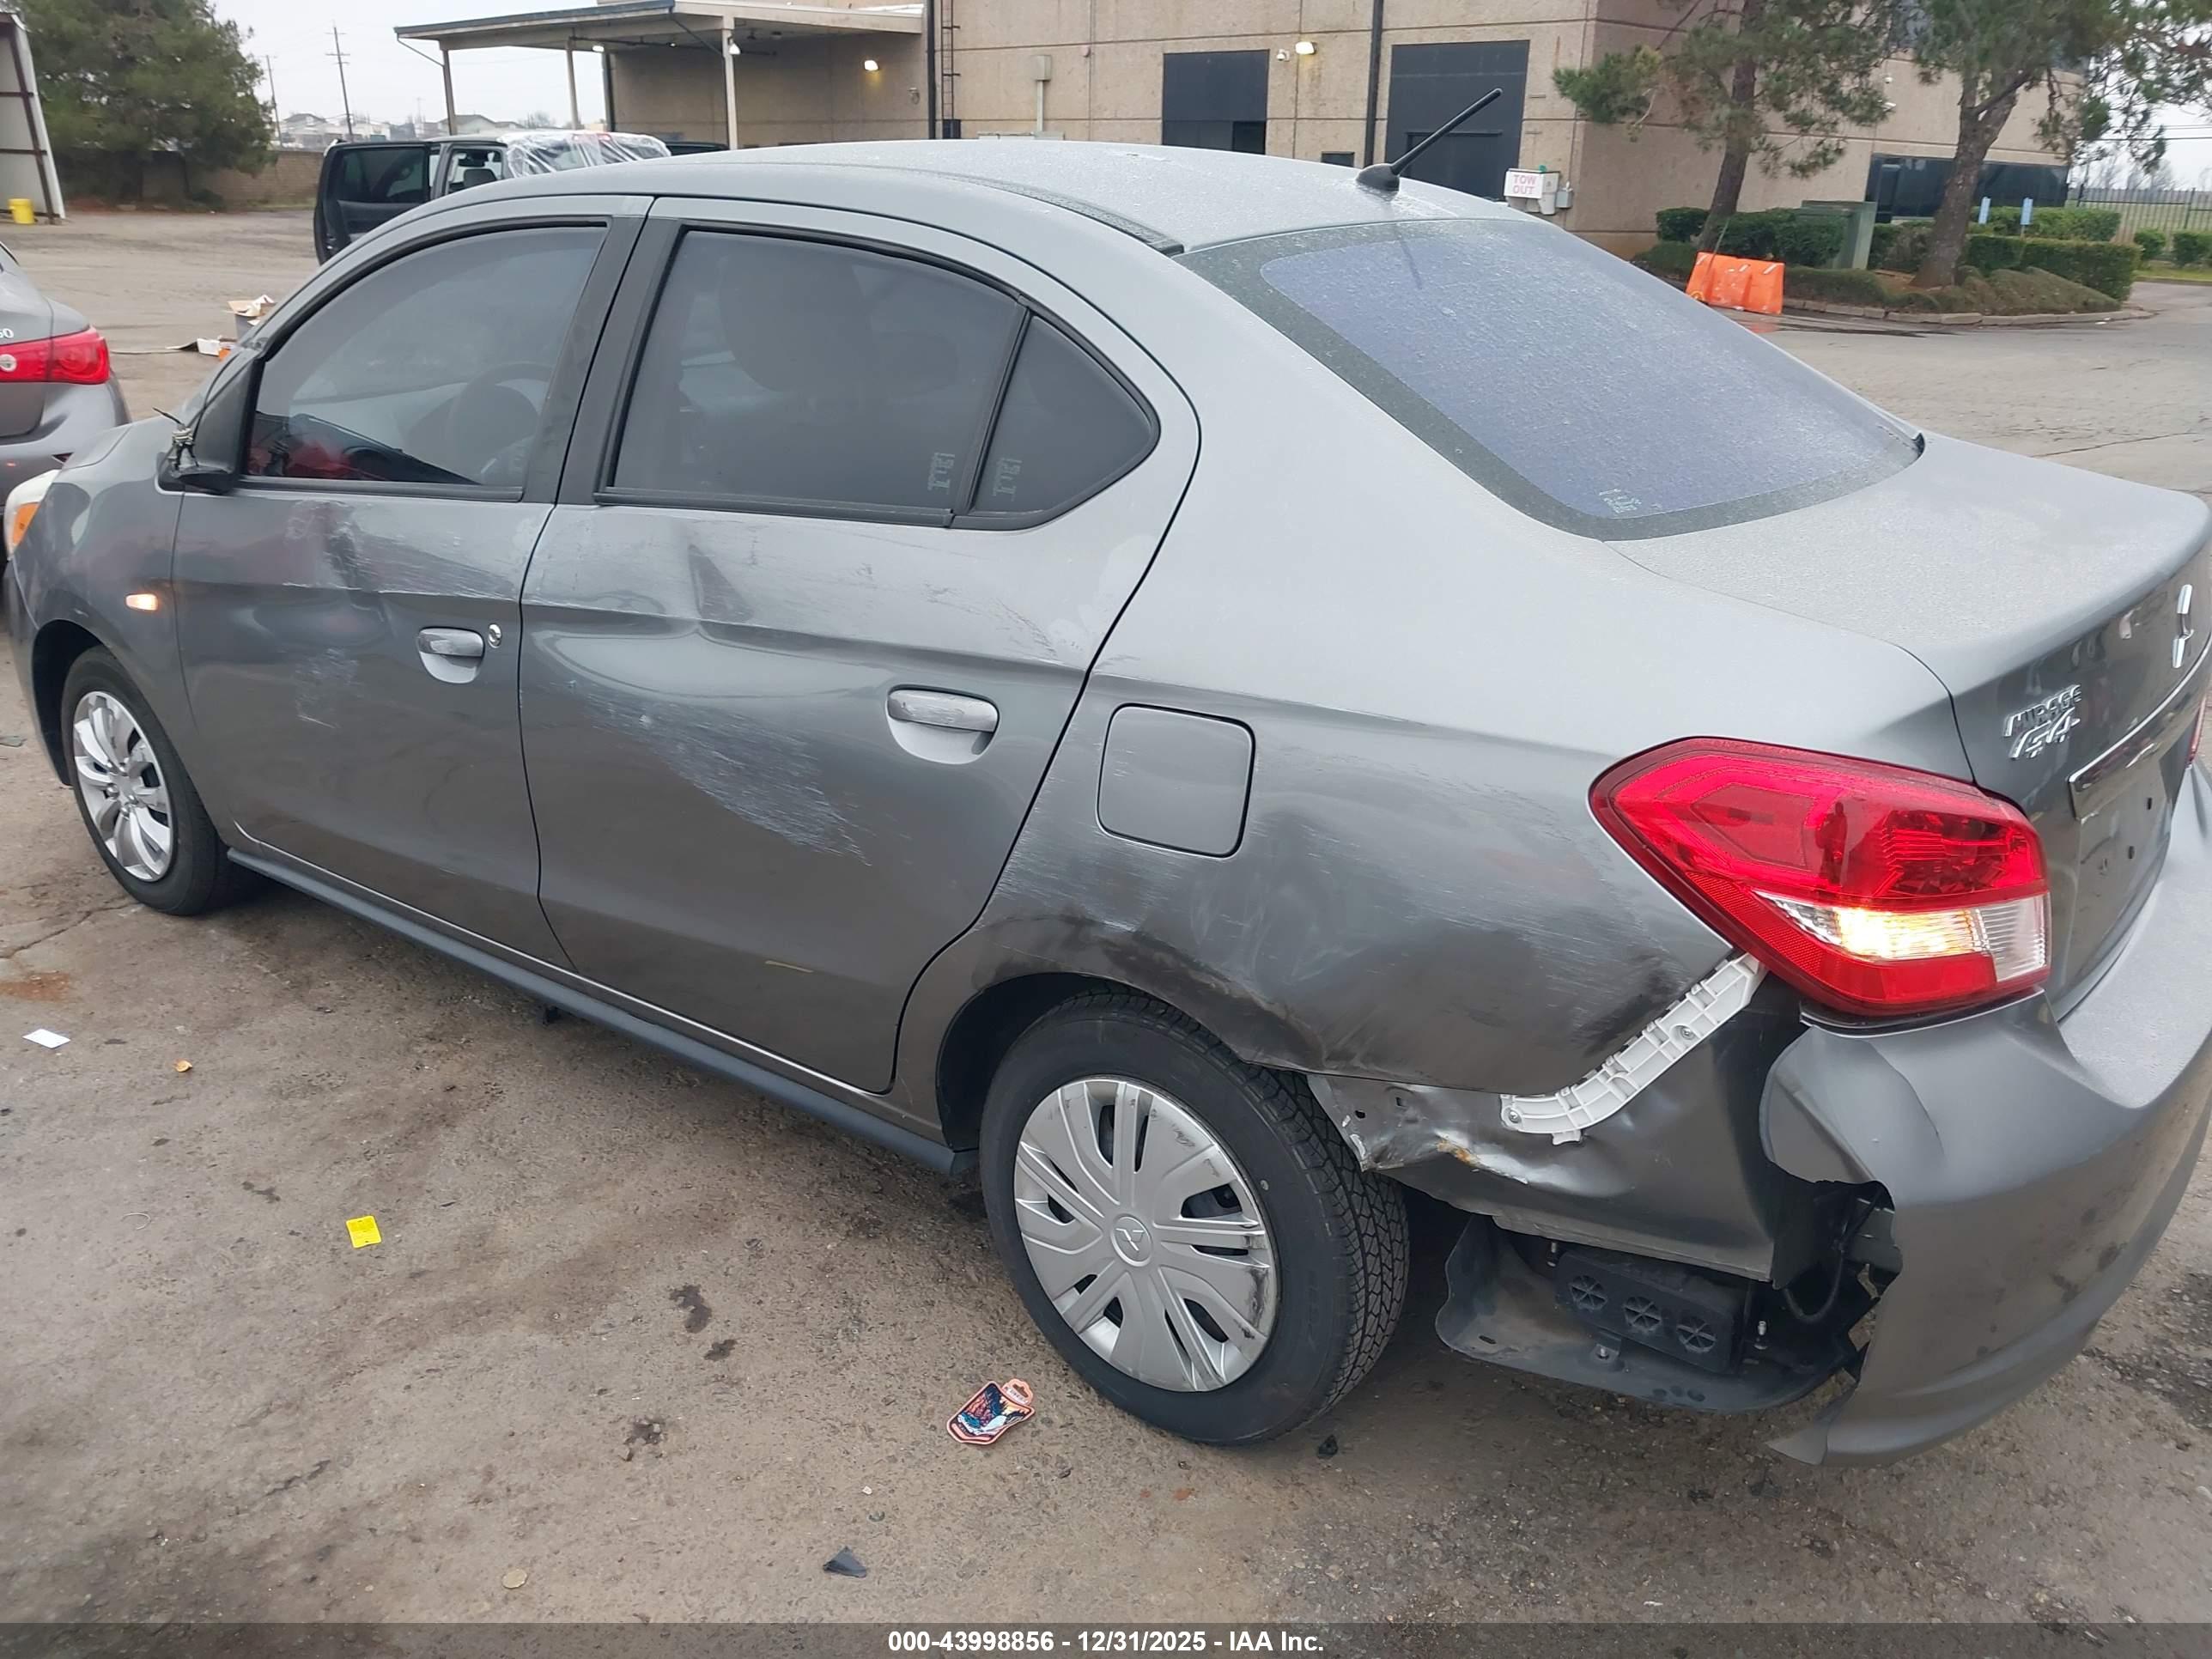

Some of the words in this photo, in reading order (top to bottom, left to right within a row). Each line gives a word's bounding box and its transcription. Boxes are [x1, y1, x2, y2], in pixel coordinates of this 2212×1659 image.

[1513, 174, 1536, 185] TOW
[1513, 185, 1534, 194] OUT
[2003, 684, 2081, 737] MIRAGE
[2008, 707, 2080, 758] G4
